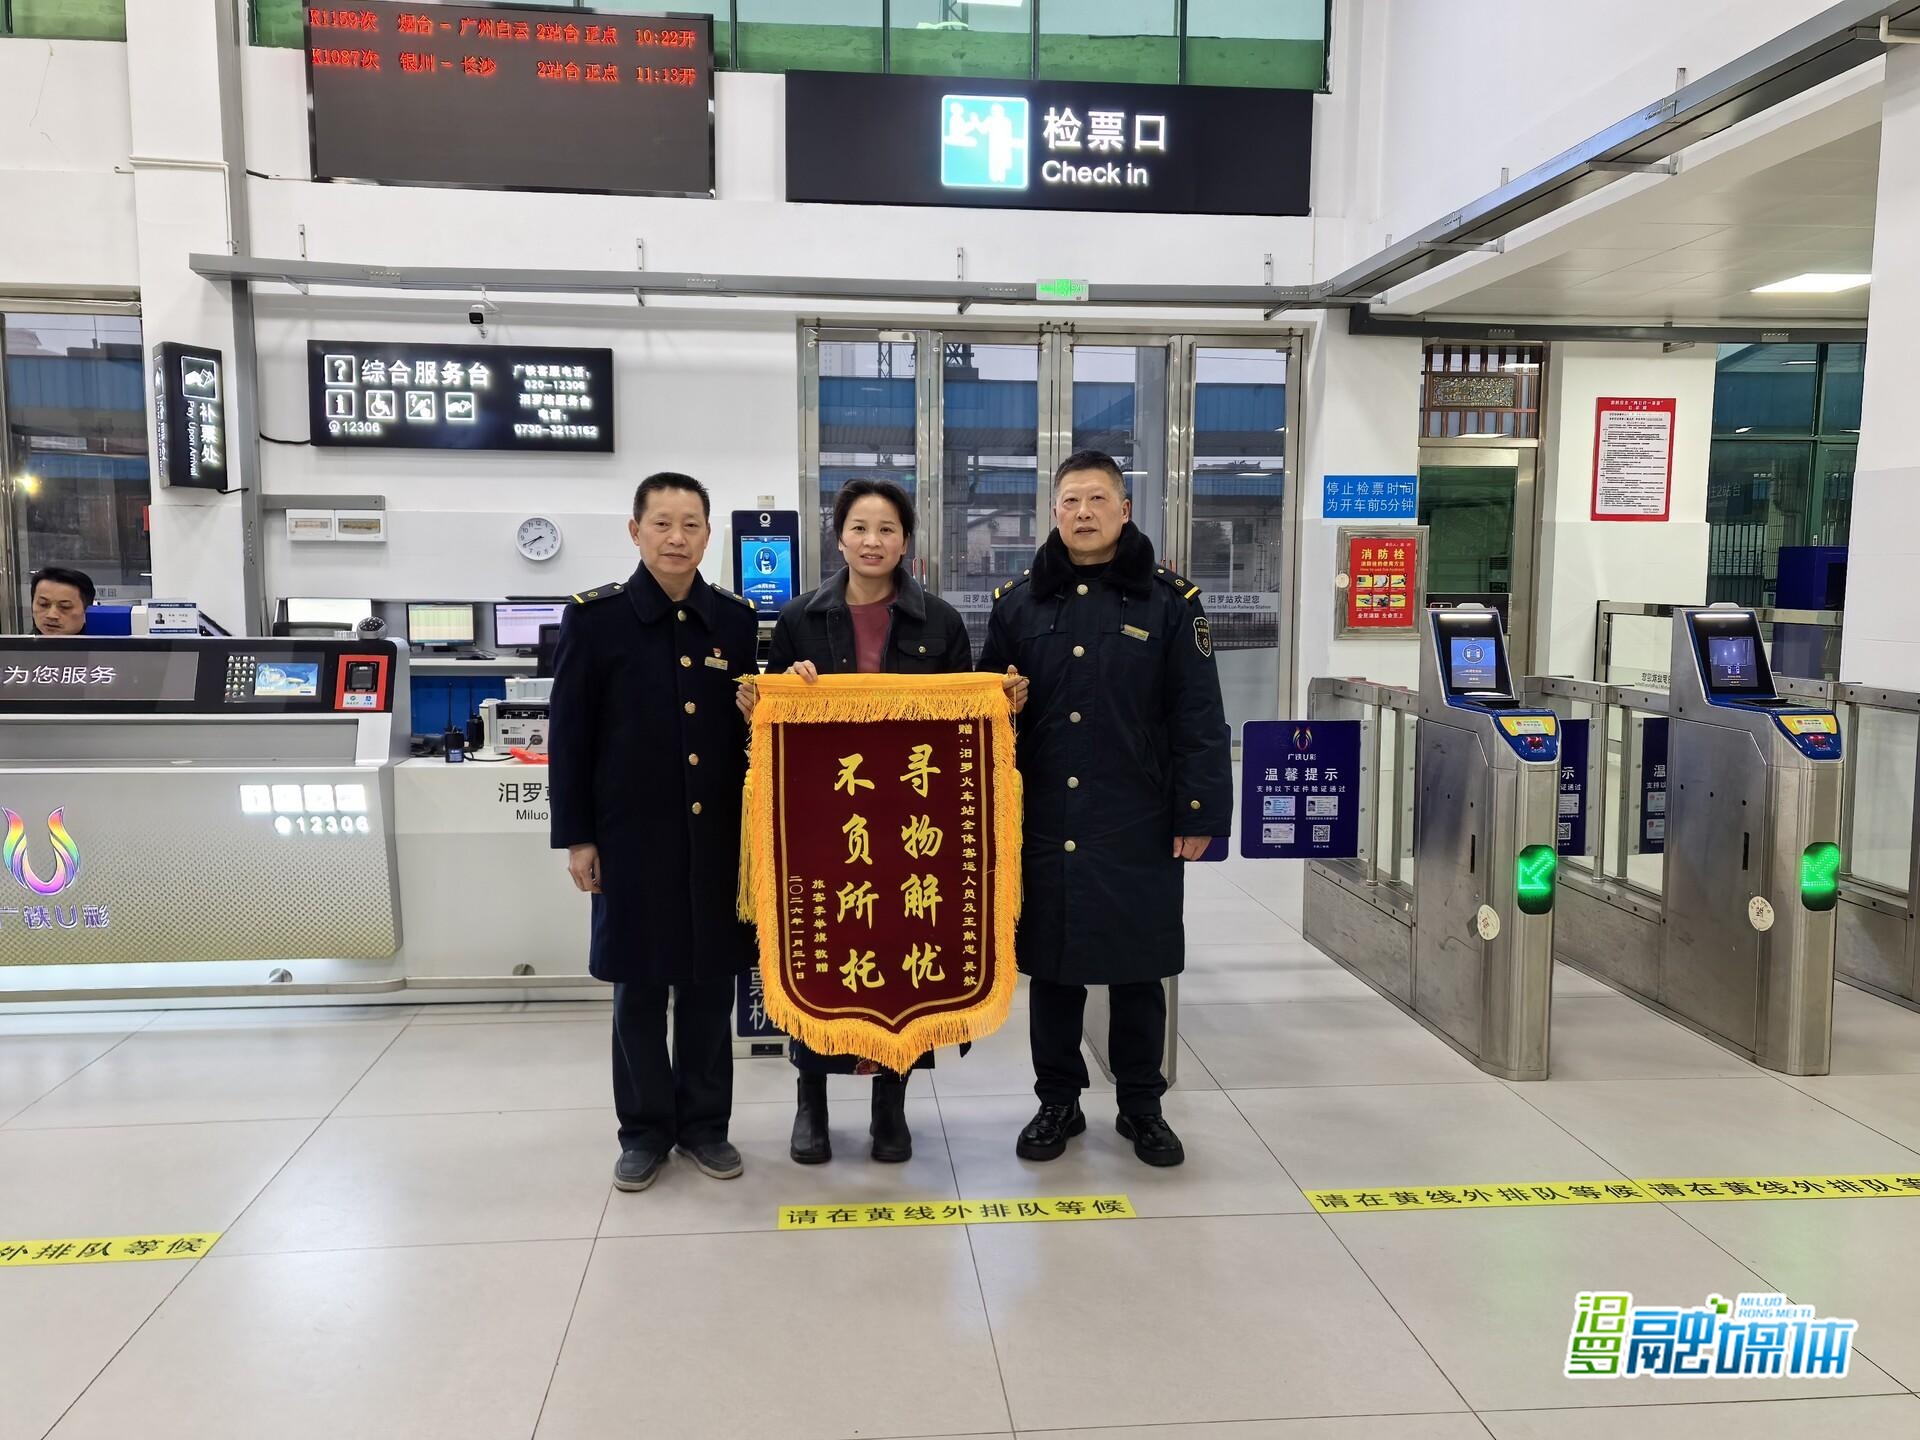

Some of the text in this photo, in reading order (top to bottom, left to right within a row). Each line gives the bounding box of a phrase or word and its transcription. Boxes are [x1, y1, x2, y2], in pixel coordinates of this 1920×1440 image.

[398, 12, 433, 34] 烟台
[459, 17, 529, 40] 广州白云
[536, 22, 579, 42] 2站台
[584, 25, 618, 44] 正点
[635, 28, 695, 48] 10:22开
[310, 48, 380, 73] K1087次
[399, 52, 435, 73] 银川
[460, 55, 498, 77] 长沙
[537, 61, 580, 81] 2站台
[585, 63, 619, 82] 正点
[636, 66, 697, 86] 11:13开
[1043, 107, 1167, 150] 检票口
[1042, 160, 1148, 184] Check in
[361, 360, 491, 386] 综合服务台
[524, 379, 587, 391] 020-12306
[200, 402, 220, 464] 补票处
[343, 422, 381, 433] 12306
[186, 400, 199, 477] Pay Upon Arrival
[1326, 481, 1414, 496] 停止检票时间
[1326, 497, 1414, 512] 为开车前5分钟
[1361, 548, 1405, 560] 消防栓
[1208, 595, 1260, 604] 汨罗站欢迎您
[3, 665, 117, 684] 为您服务
[1287, 753, 1317, 761] 广铁U彩
[1264, 767, 1338, 781] 温馨提示
[1562, 767, 1575, 780] 示
[1653, 764, 1666, 777] 温
[1256, 785, 1346, 793] 支持以下证件验证通过
[296, 815, 369, 834] 12306
[516, 809, 549, 821] Miluo
[835, 754, 885, 993] 不负所托
[900, 744, 945, 989] 寻物解忧
[1316, 1183, 1643, 1208] 请在黄线外排队等候
[786, 1199, 1126, 1225] 请在黄线外排队等候
[0, 1238, 206, 1261] 外排队等候
